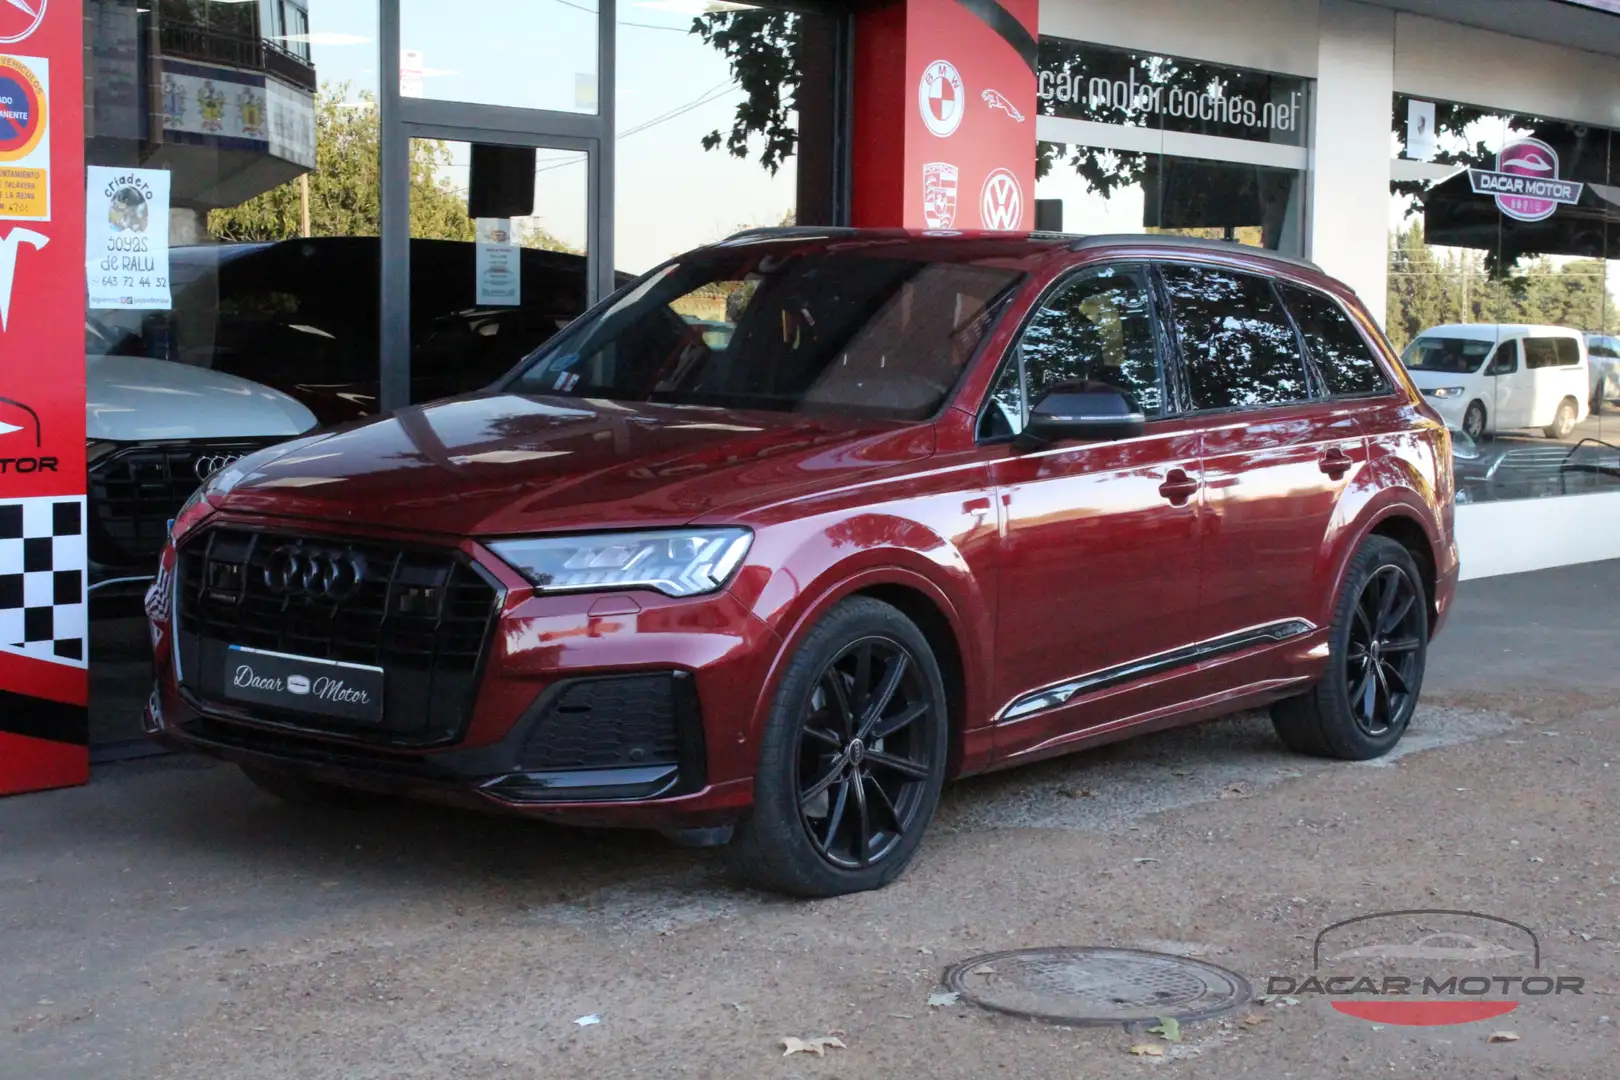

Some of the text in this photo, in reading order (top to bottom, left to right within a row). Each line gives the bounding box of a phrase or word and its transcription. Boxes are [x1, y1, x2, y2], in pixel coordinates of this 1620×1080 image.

[925, 65, 960, 89] BMW
[104, 173, 153, 200] criadero
[1480, 174, 1572, 198] DACAR MOTOR
[123, 276, 134, 287] 72
[138, 276, 151, 288] 44
[156, 277, 167, 288] 32
[233, 664, 371, 704] Dacar Motor
